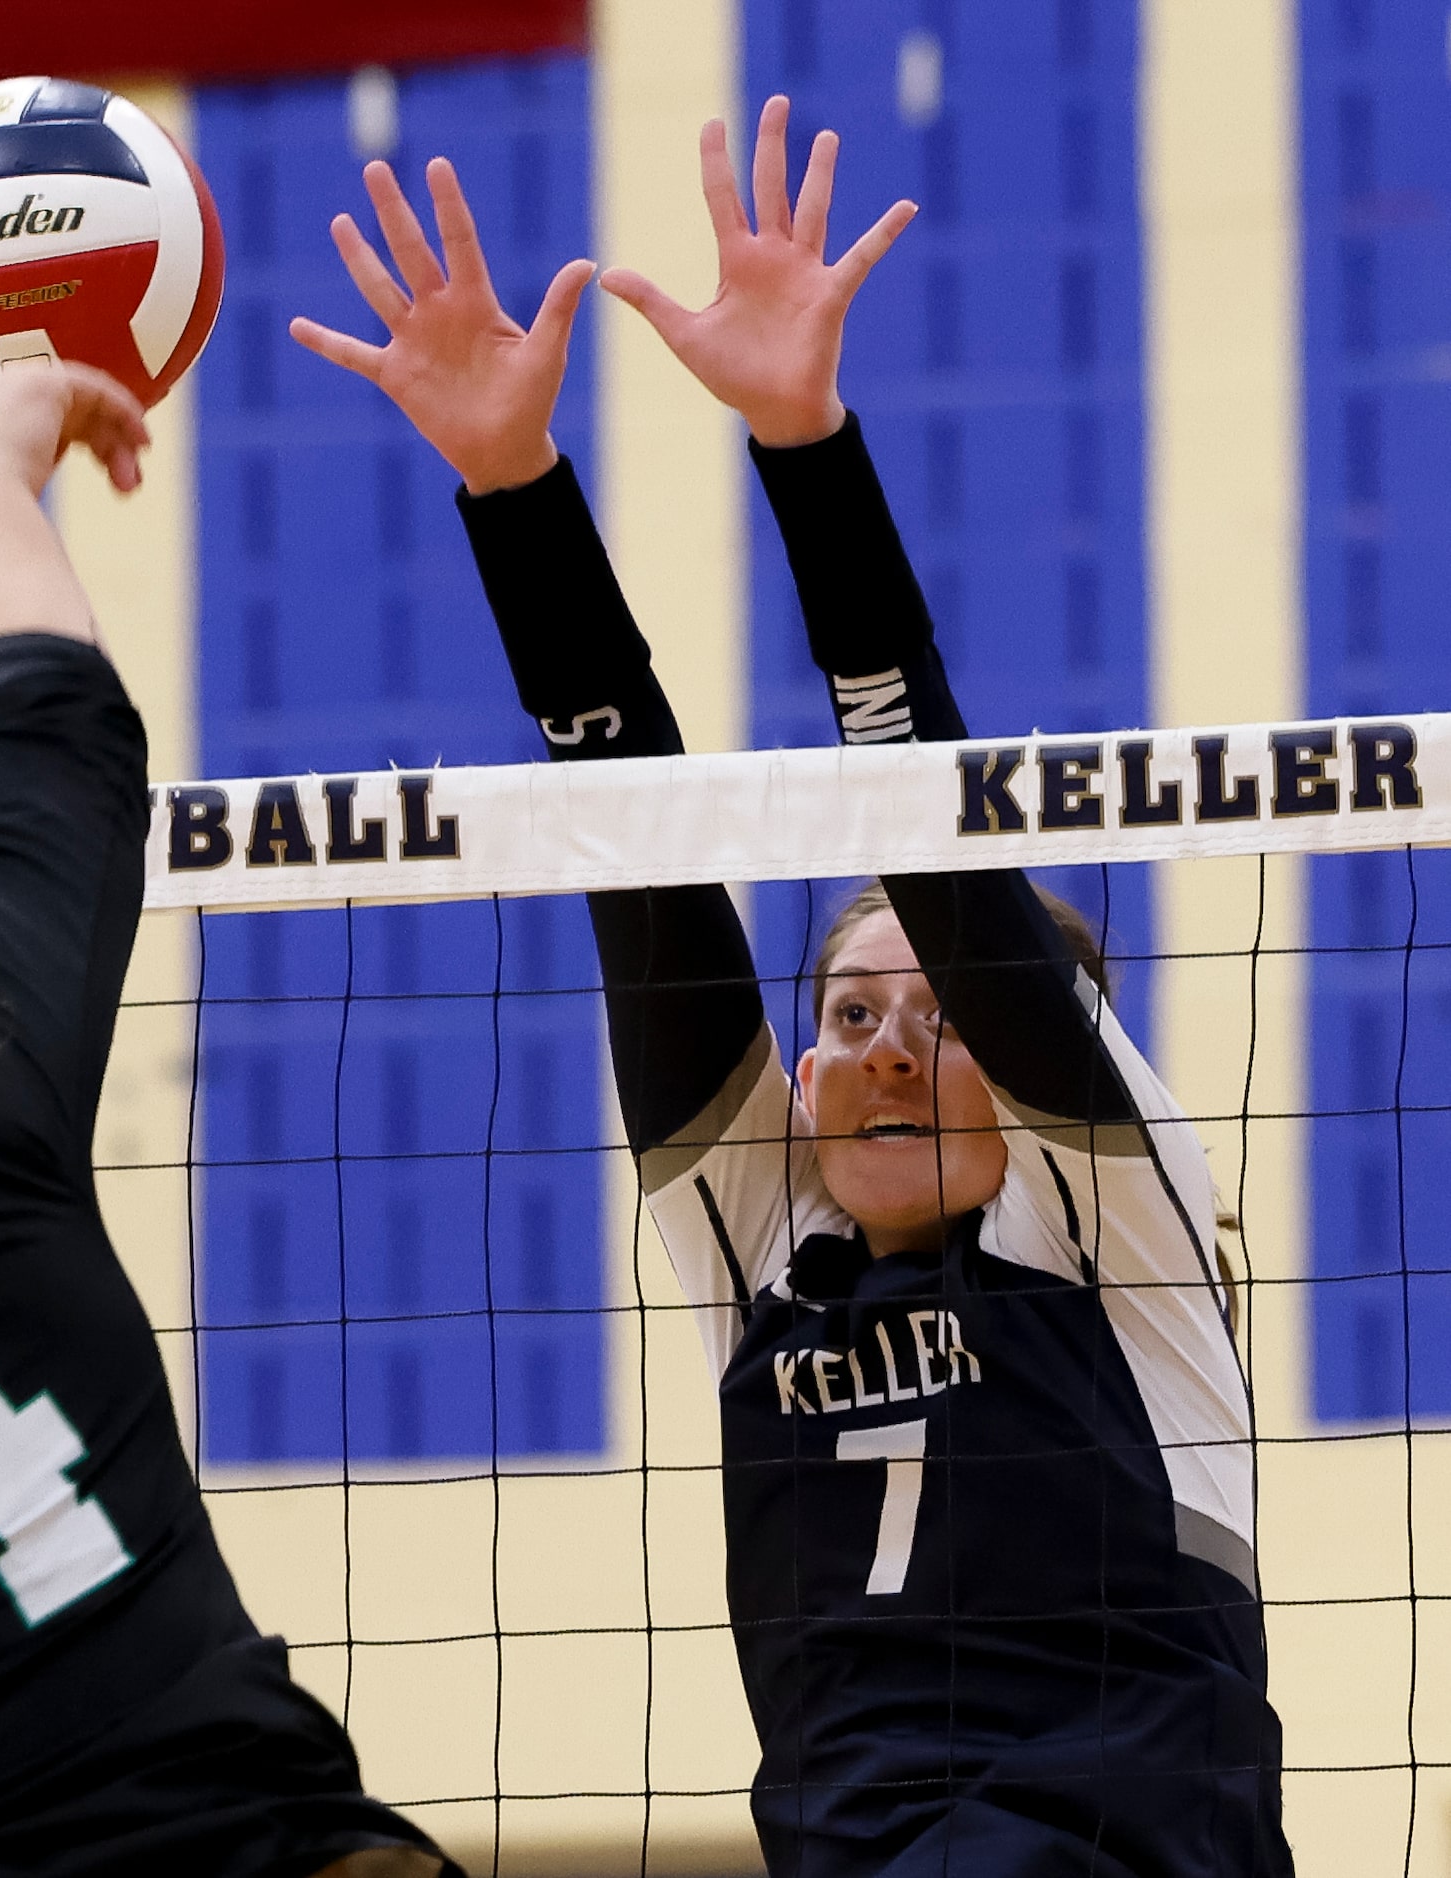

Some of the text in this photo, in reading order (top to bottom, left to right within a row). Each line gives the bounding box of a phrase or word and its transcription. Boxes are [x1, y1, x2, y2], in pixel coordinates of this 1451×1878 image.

[956, 722, 1423, 837] KELLER
[773, 1309, 982, 1415] KELLER
[836, 1417, 927, 1595] 7
